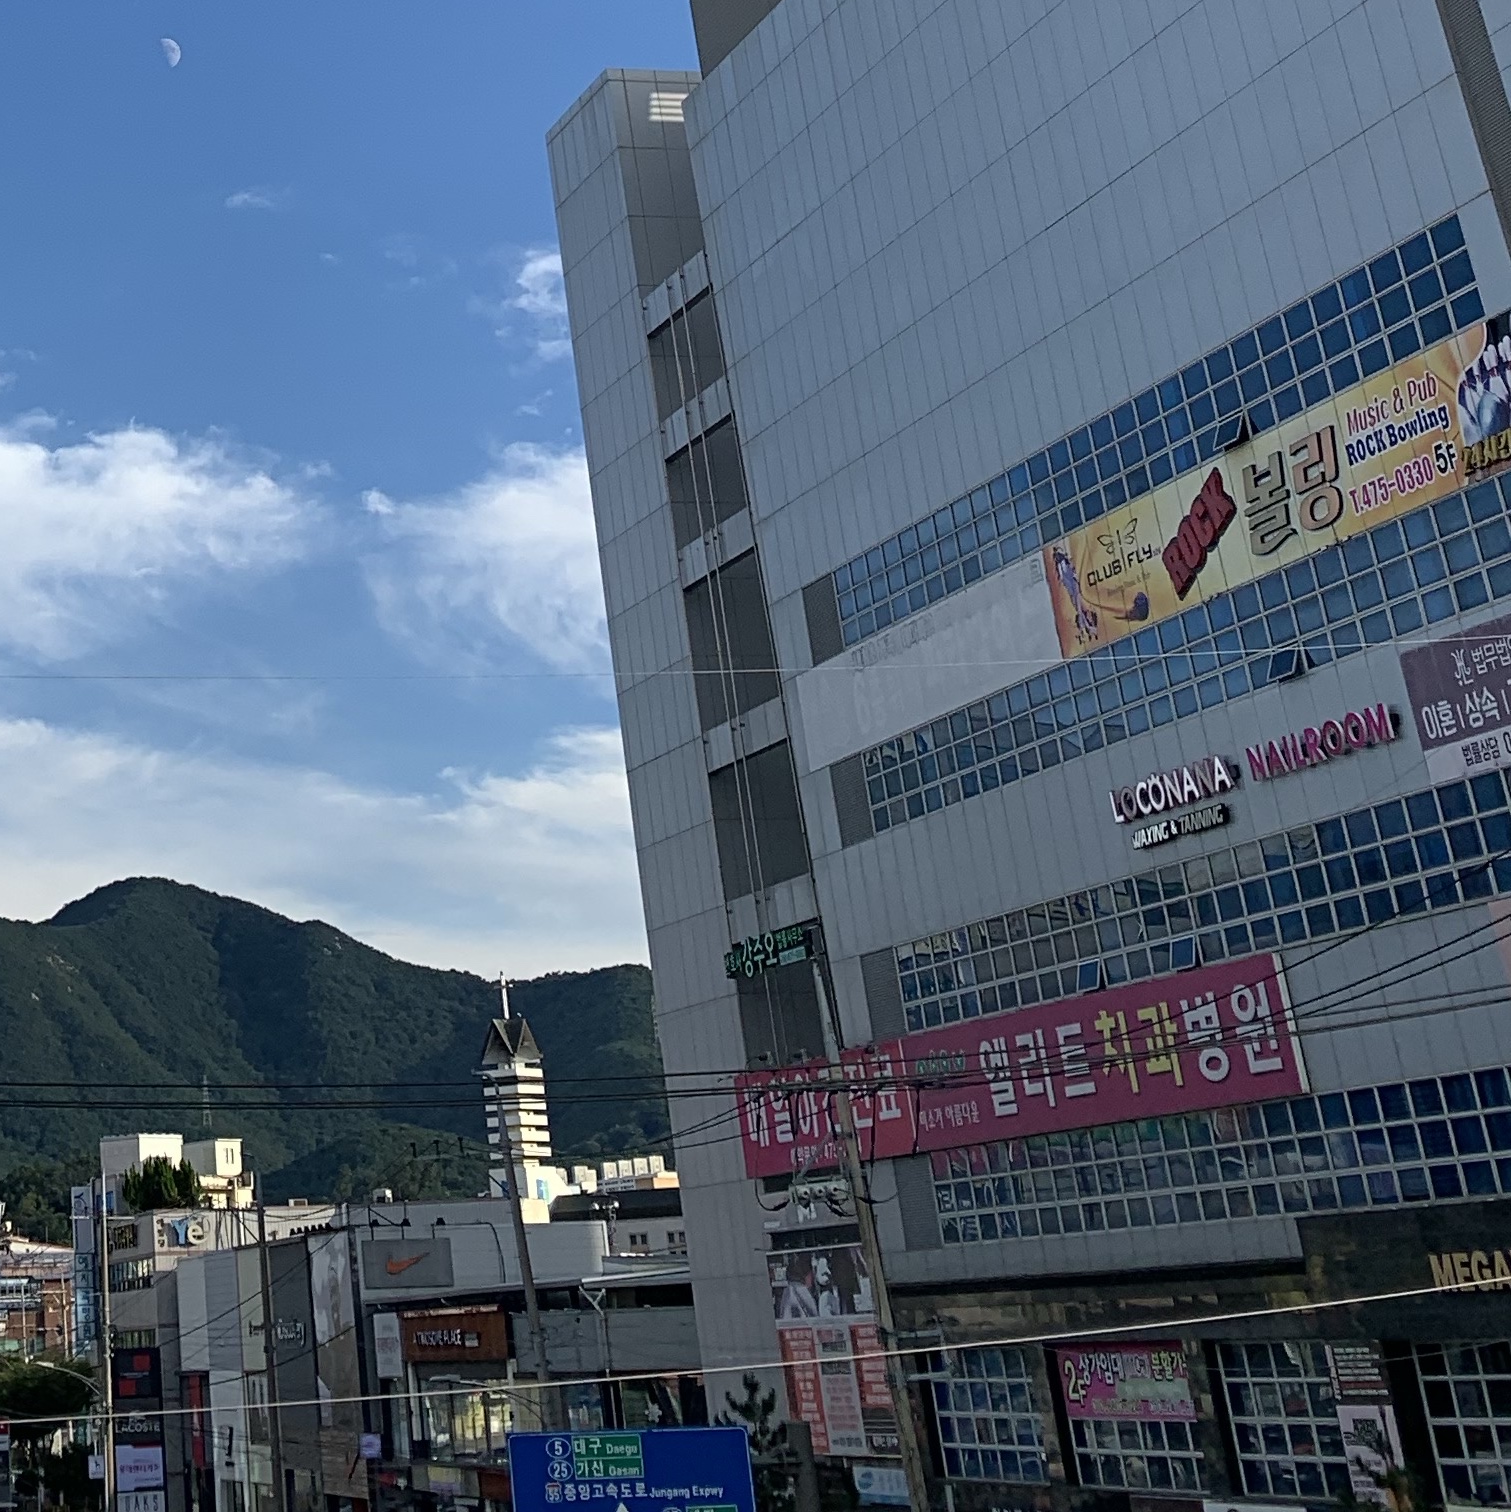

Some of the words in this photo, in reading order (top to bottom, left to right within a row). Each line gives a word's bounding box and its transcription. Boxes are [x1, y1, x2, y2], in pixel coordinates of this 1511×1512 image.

[1346, 396, 1389, 436] Music
[1393, 387, 1404, 415] &
[1406, 372, 1437, 405] Pub
[1345, 427, 1388, 467] ROCK
[1387, 404, 1449, 446] Bowling
[1433, 443, 1457, 474] 5F
[1242, 425, 1344, 556] 볼링
[1349, 456, 1434, 514] T.475-0330
[1162, 467, 1237, 601] ROCK
[1421, 700, 1457, 739] 이혼
[1465, 686, 1500, 728] 상속
[1246, 703, 1395, 781] NAILROOM
[1133, 821, 1169, 849] WAXING
[1178, 803, 1224, 833] TANNING
[743, 932, 777, 978] 강수오
[945, 1100, 980, 1127] 아름다운
[116, 1422, 161, 1434] LACOSTE
[554, 1441, 563, 1455] 5
[573, 1438, 602, 1456] 대구
[606, 1444, 638, 1457] Daegu
[553, 1463, 568, 1478] 25
[609, 1465, 640, 1477] Gasan
[564, 1483, 648, 1501] 중앙고속도로
[649, 1486, 690, 1499] Jungang
[692, 1486, 724, 1498] Expwy
